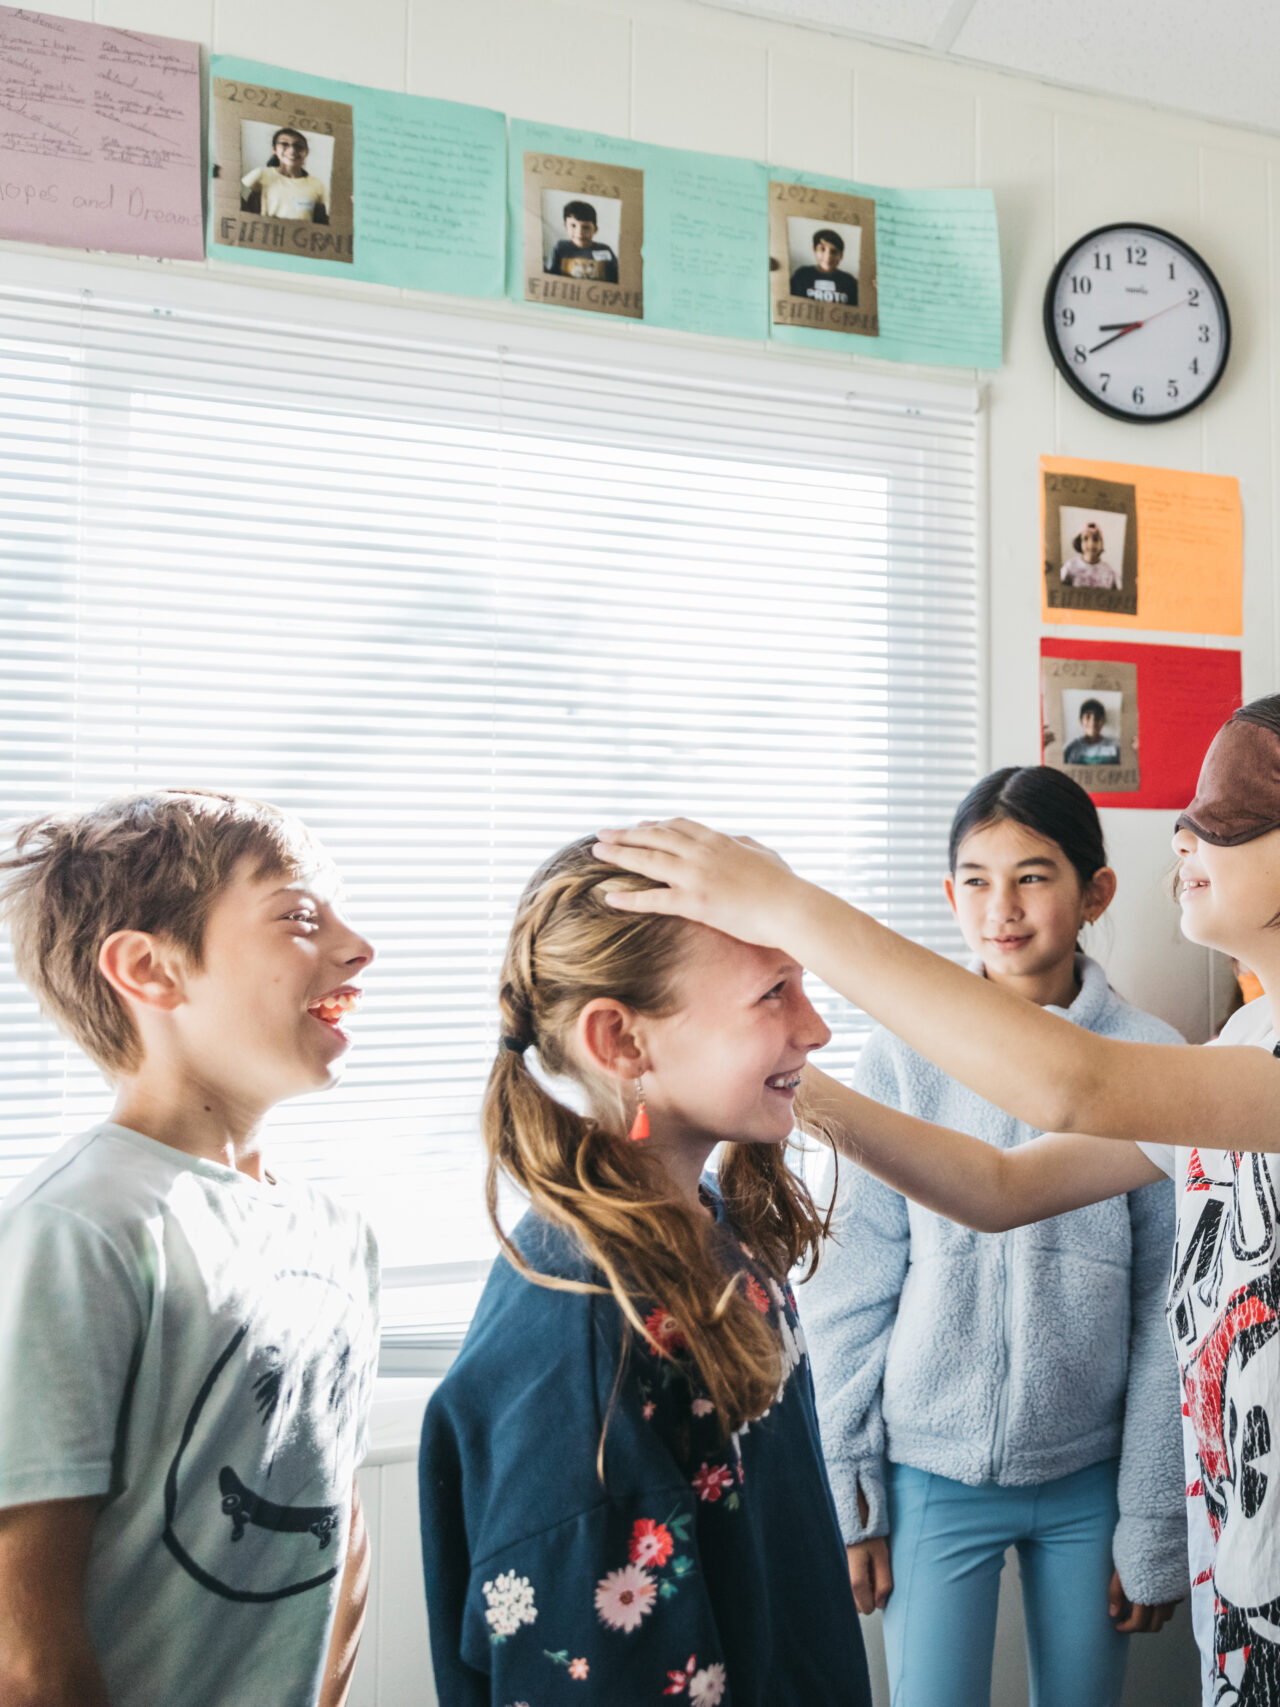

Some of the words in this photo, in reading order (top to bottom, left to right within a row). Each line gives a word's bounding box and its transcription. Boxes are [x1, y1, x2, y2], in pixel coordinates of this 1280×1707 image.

[225, 82, 283, 111] 2022
[287, 115, 334, 135] 2023
[532, 156, 577, 177] 2022
[775, 183, 819, 205] 2022
[72, 183, 115, 209] and
[127, 186, 203, 228] Dreams
[221, 216, 286, 248] FIFTH
[1093, 252, 1112, 271] 11
[1126, 247, 1147, 266] 12
[1168, 262, 1175, 280] 1
[527, 277, 582, 302] FIFTH
[1071, 275, 1091, 295] 10
[1188, 288, 1199, 307] 2
[776, 299, 826, 323] FIFTH
[1062, 308, 1075, 327] 9
[1198, 324, 1210, 344] 3
[1074, 345, 1087, 365] 8
[1188, 356, 1199, 375] 4
[1100, 373, 1111, 393] 7
[1167, 379, 1178, 398] 5
[1132, 387, 1144, 405] 6
[1052, 662, 1089, 678] 2022
